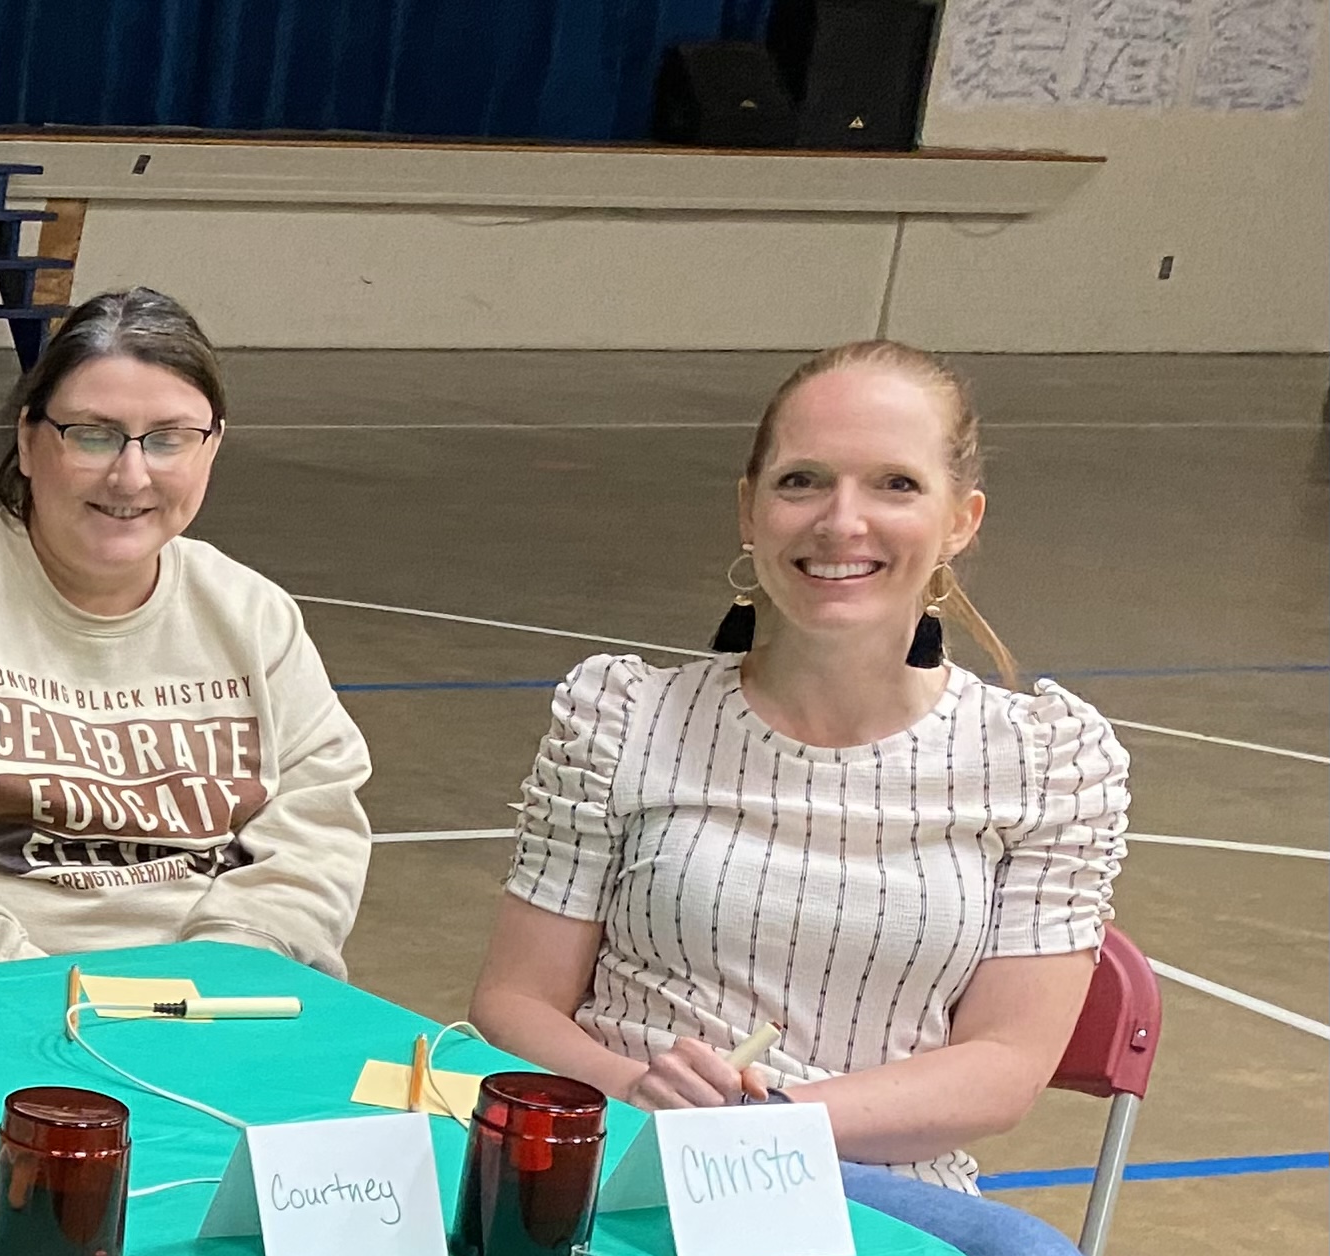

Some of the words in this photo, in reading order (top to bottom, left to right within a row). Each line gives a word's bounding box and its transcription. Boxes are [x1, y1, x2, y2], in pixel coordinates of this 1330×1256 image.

[75, 688, 145, 711] BLACK
[154, 674, 253, 707] HISTORY
[681, 1137, 816, 1205] Christa
[270, 1172, 402, 1225] Courtney
